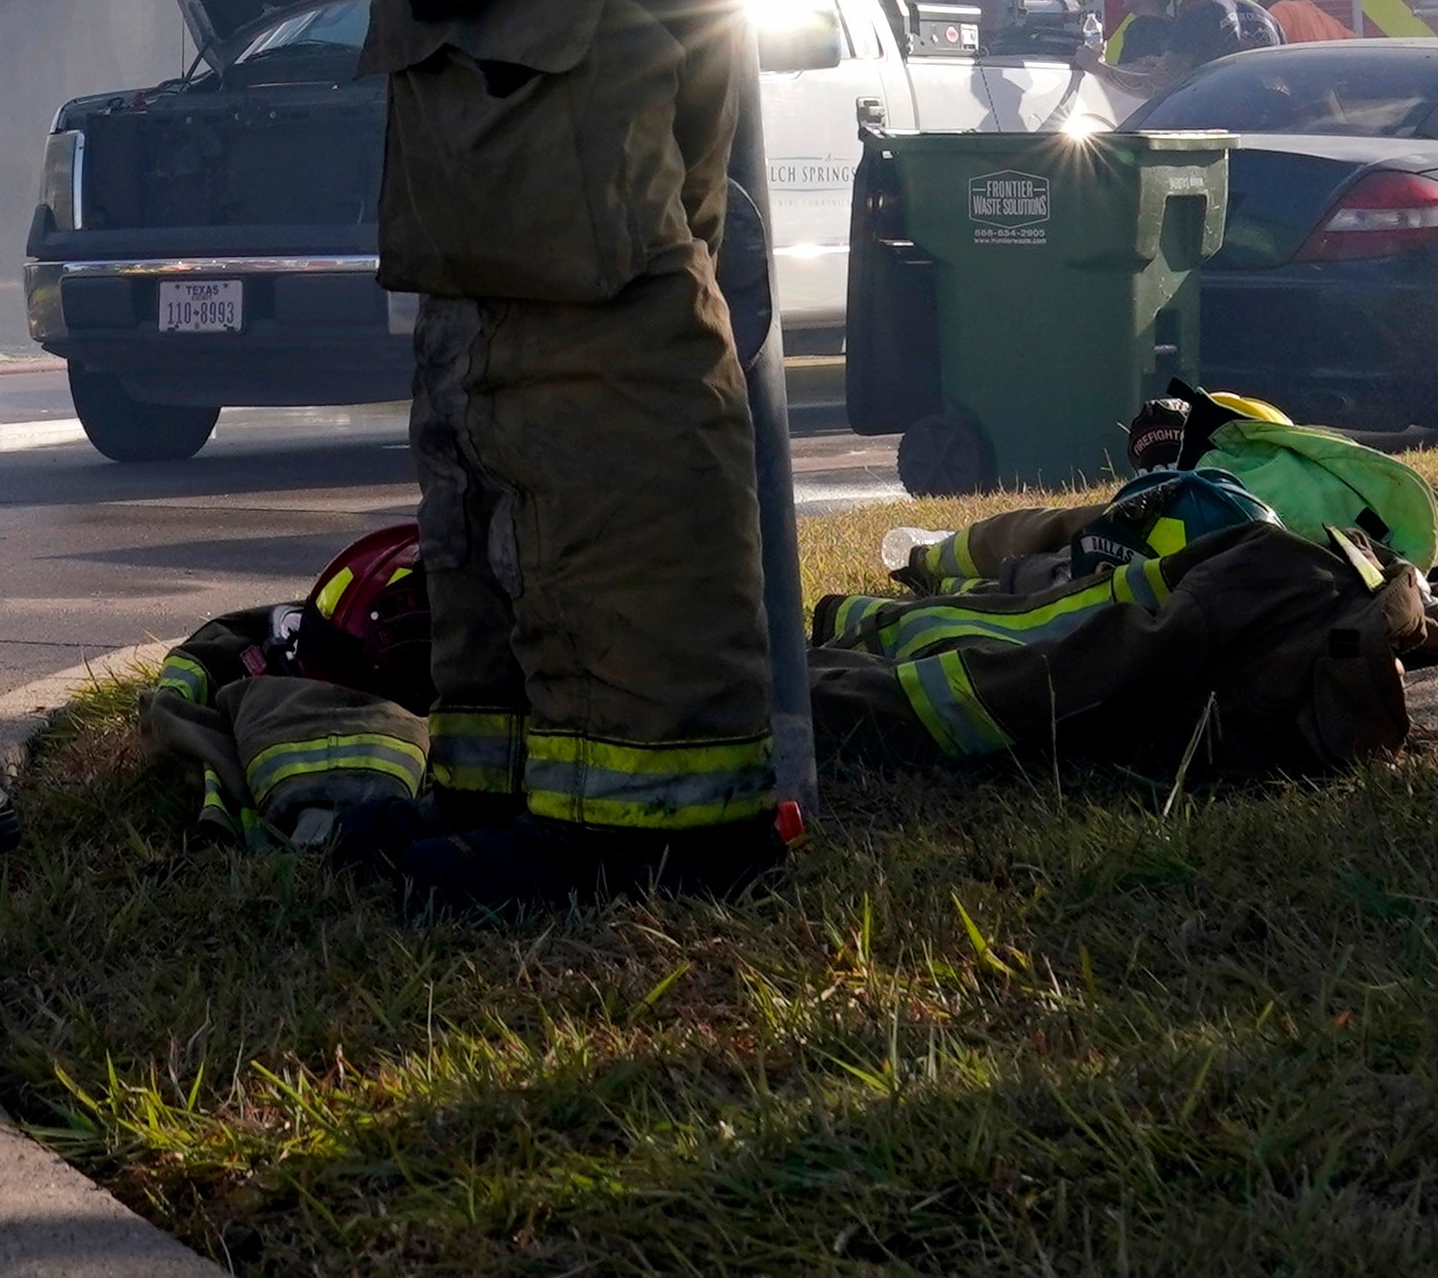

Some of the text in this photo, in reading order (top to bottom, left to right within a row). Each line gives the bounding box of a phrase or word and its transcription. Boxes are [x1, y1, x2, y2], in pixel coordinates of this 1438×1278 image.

[986, 180, 1034, 198] FRONTIER
[973, 194, 1047, 216] WASTE SOLUTIONS
[186, 285, 219, 295] TEXAS
[1091, 537, 1134, 562] DALLAS
